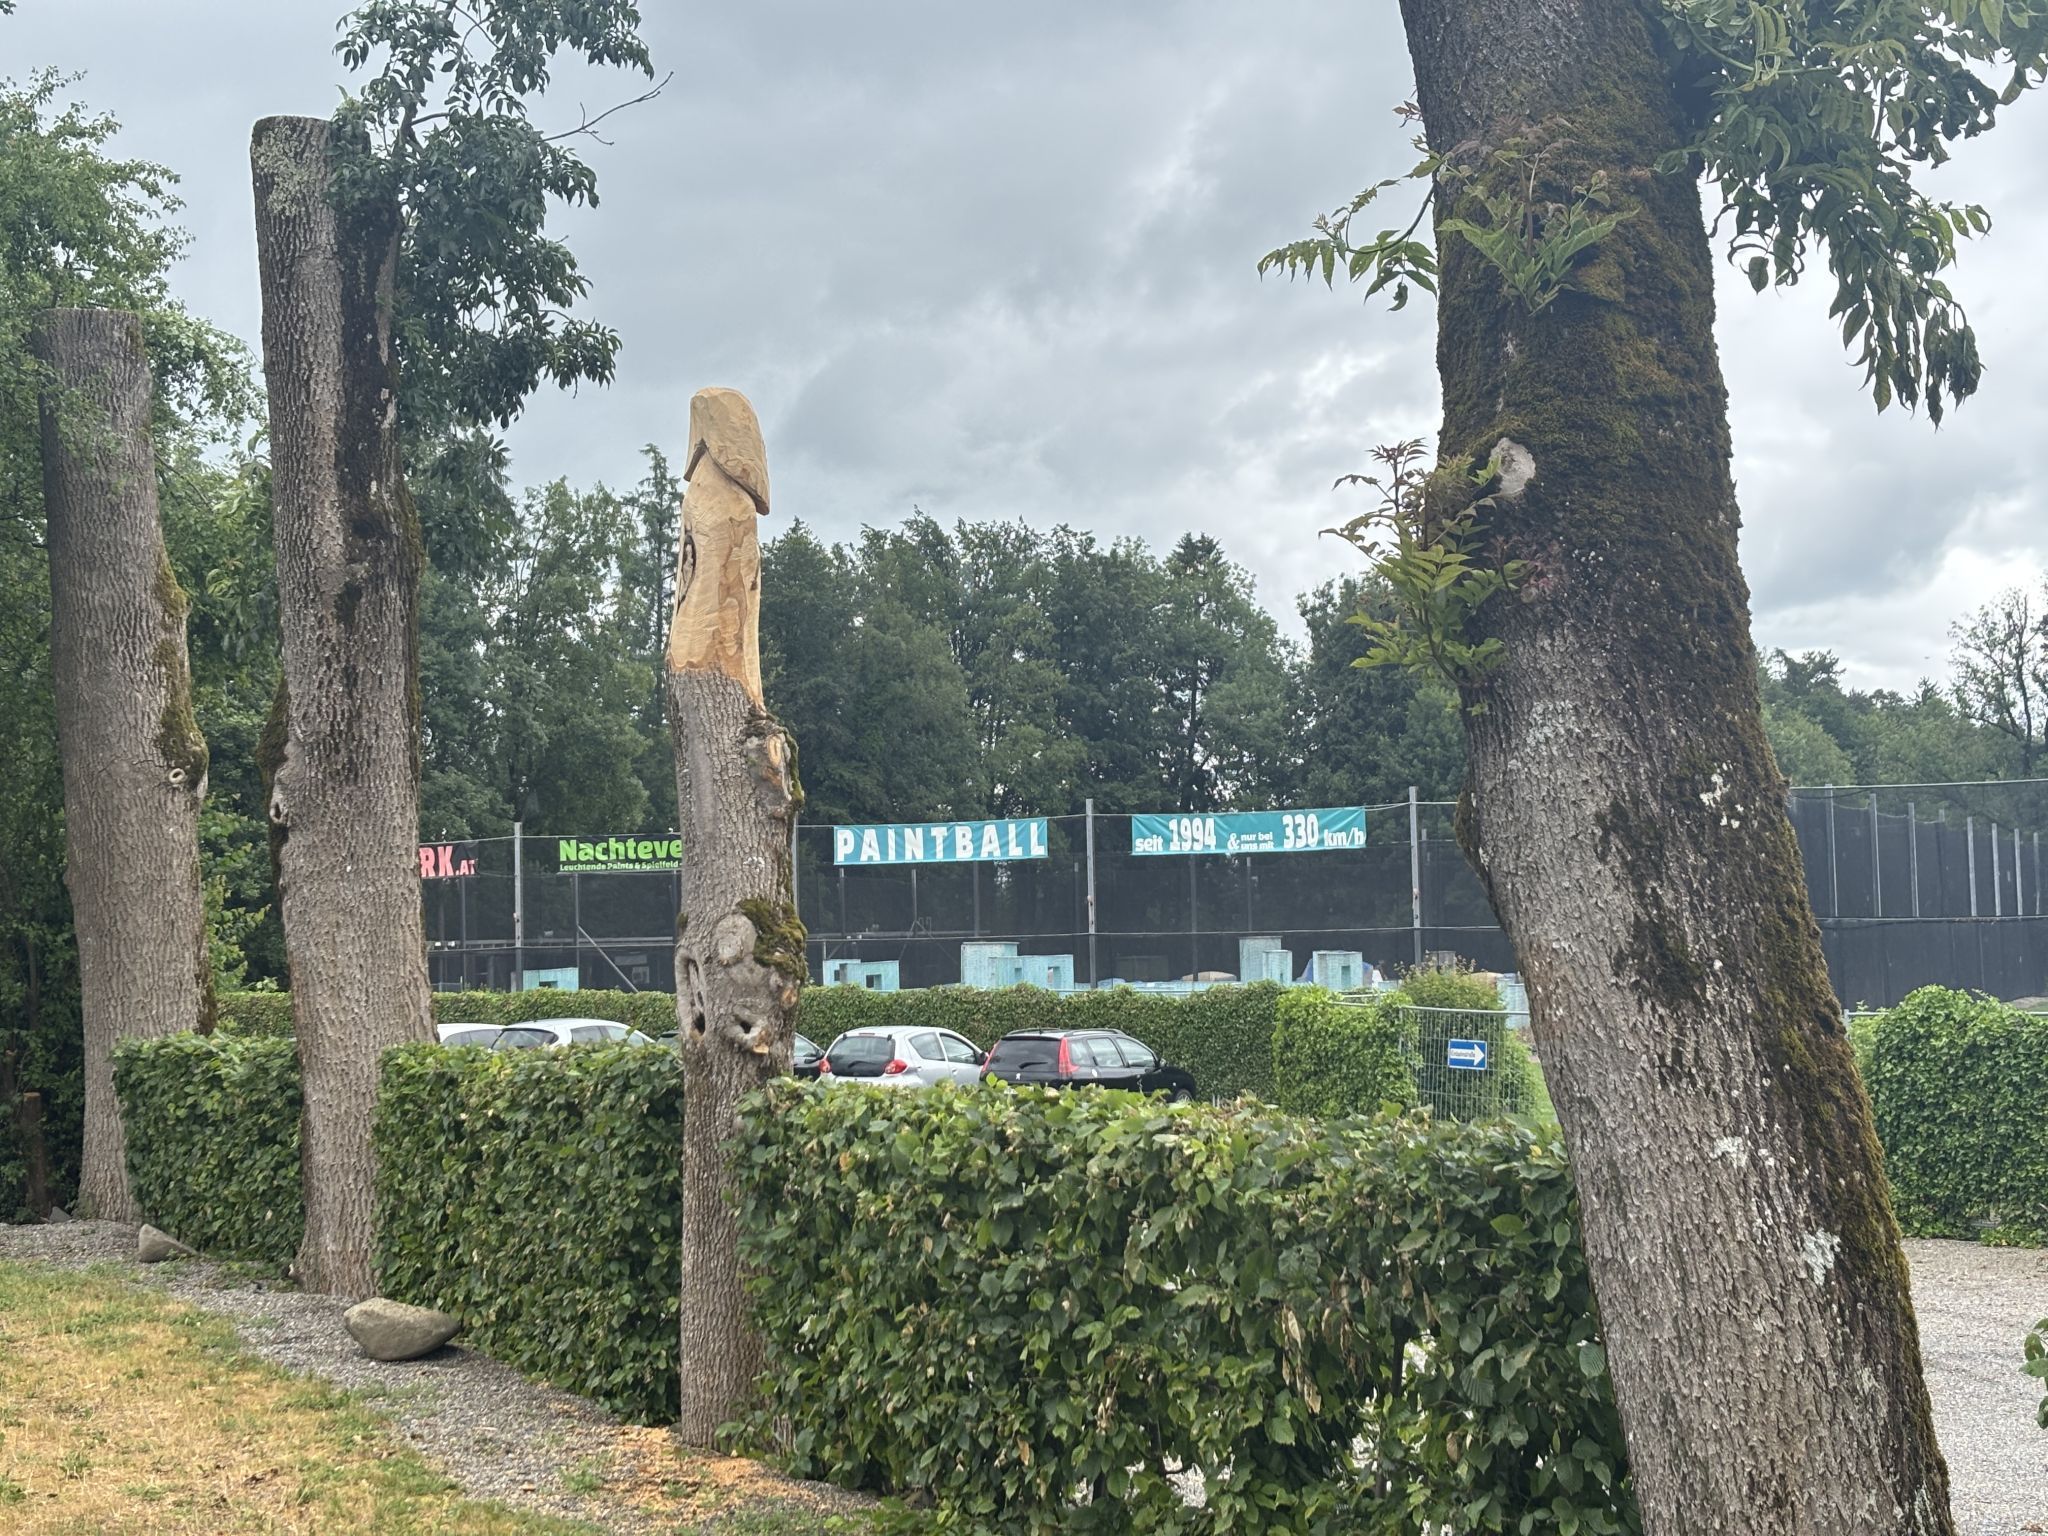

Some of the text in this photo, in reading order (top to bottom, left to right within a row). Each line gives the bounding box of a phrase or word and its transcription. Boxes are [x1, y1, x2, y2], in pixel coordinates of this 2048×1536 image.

[836, 822, 1045, 862] PAINTBALL
[1135, 817, 1240, 852] seit 1994 &
[1240, 831, 1273, 841] nur bei
[1282, 812, 1365, 849] 330 km/h
[559, 837, 682, 862] Nachteve
[1240, 841, 1274, 850] uns mit
[559, 862, 607, 871] Leuchtende
[607, 861, 633, 870] Paints
